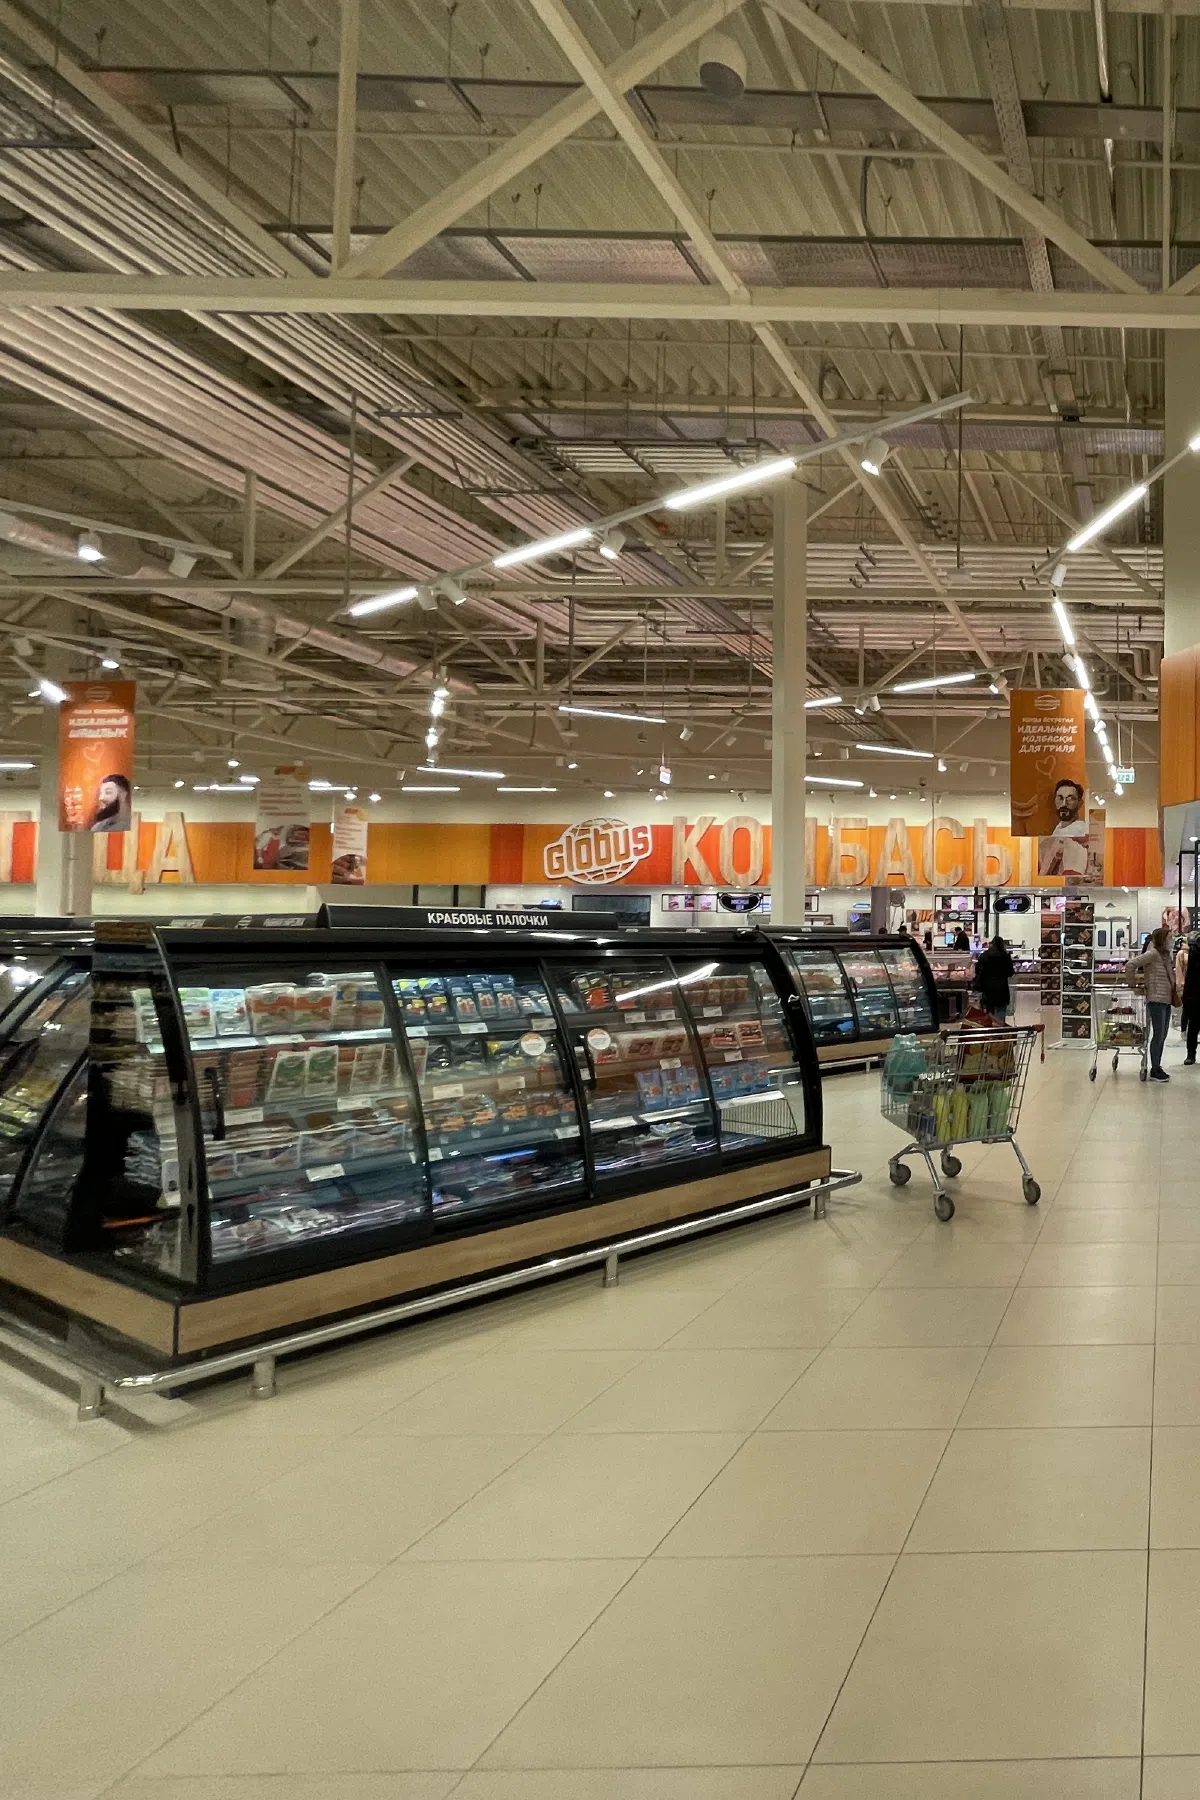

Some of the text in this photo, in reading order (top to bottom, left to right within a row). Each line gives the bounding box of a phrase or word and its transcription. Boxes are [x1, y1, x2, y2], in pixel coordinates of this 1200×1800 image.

[1017, 725, 1078, 734] ИДЕАЛЬНЫЕ
[1022, 735, 1073, 744] КОЛБАСКИ
[1018, 744, 1076, 754] ДЛЯ ГРИЛЯ
[544, 824, 653, 880] Globus
[427, 912, 548, 926] КРАБОВЫЕ ПАЛОЧКИ
